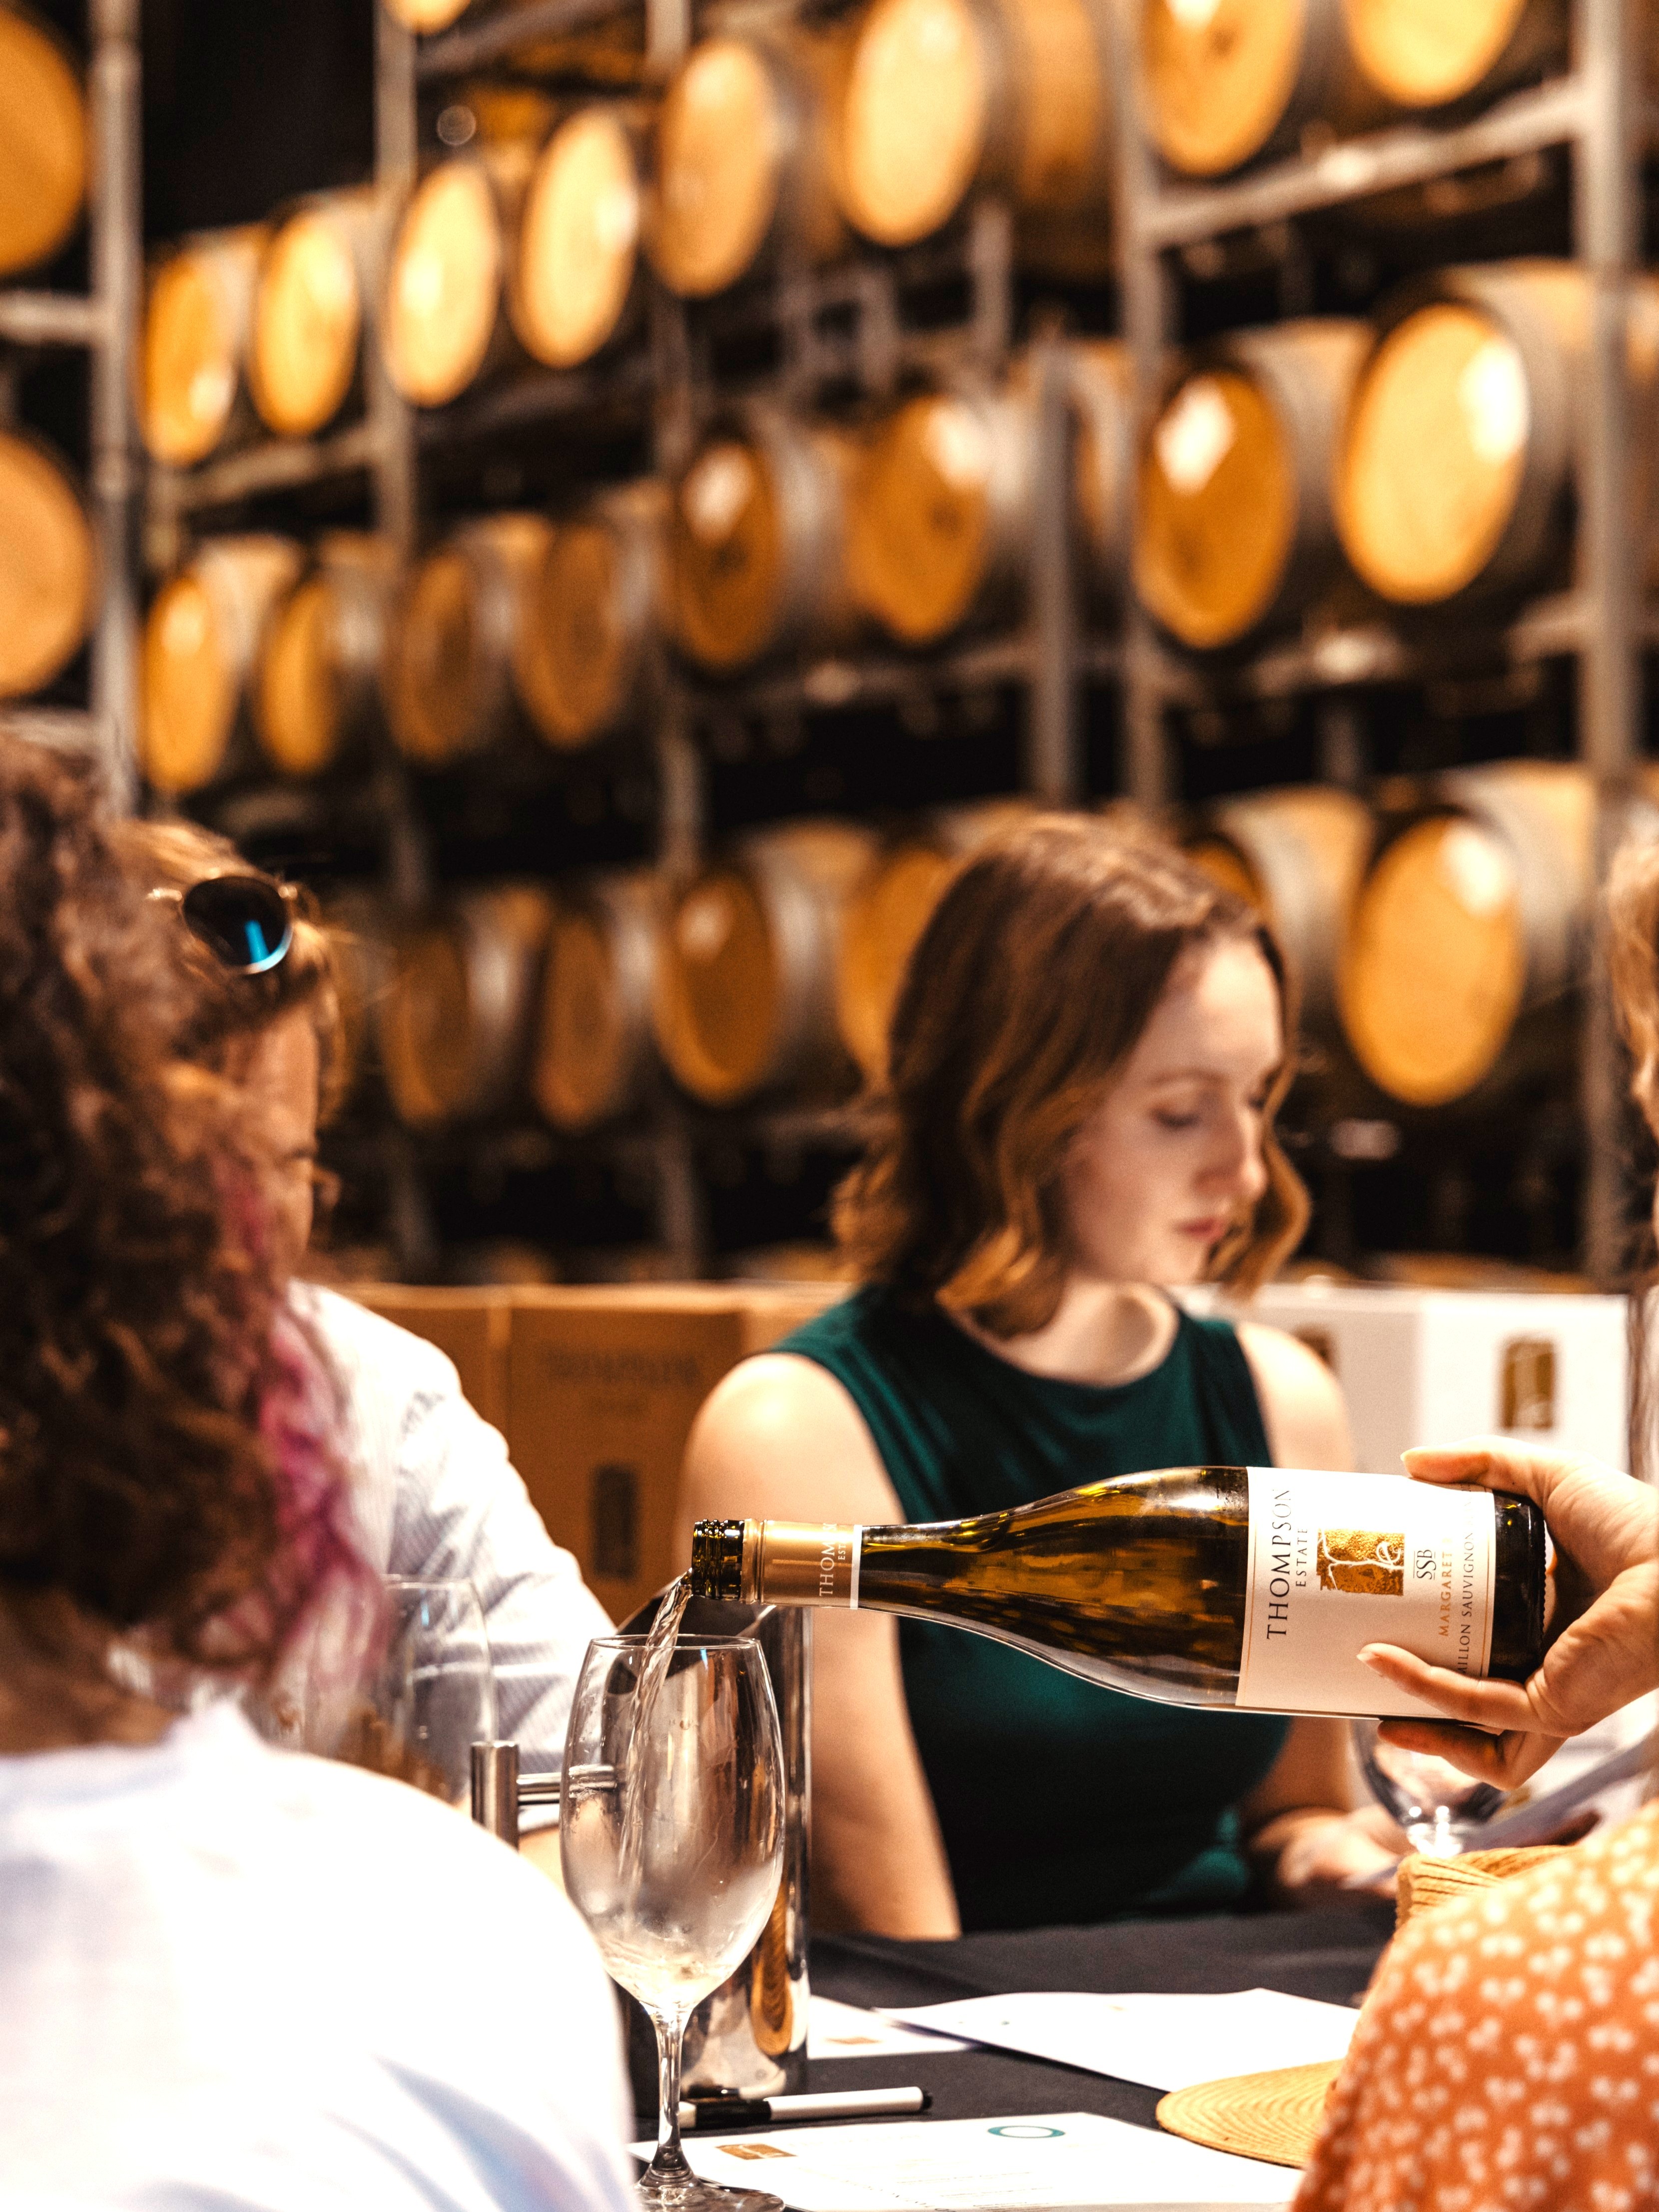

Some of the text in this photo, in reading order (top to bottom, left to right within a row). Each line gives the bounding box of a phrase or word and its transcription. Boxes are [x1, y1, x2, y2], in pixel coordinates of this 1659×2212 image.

[819, 1523, 837, 1597] THOMS
[1267, 1489, 1291, 1640] THOMPSON
[1295, 1528, 1308, 1587] ESTATE
[1416, 1549, 1437, 1580] SSB
[1438, 1552, 1453, 1637] MARGARET
[1461, 1533, 1474, 1617] SAUVIGNON
[1457, 1624, 1471, 1673] MILLON
